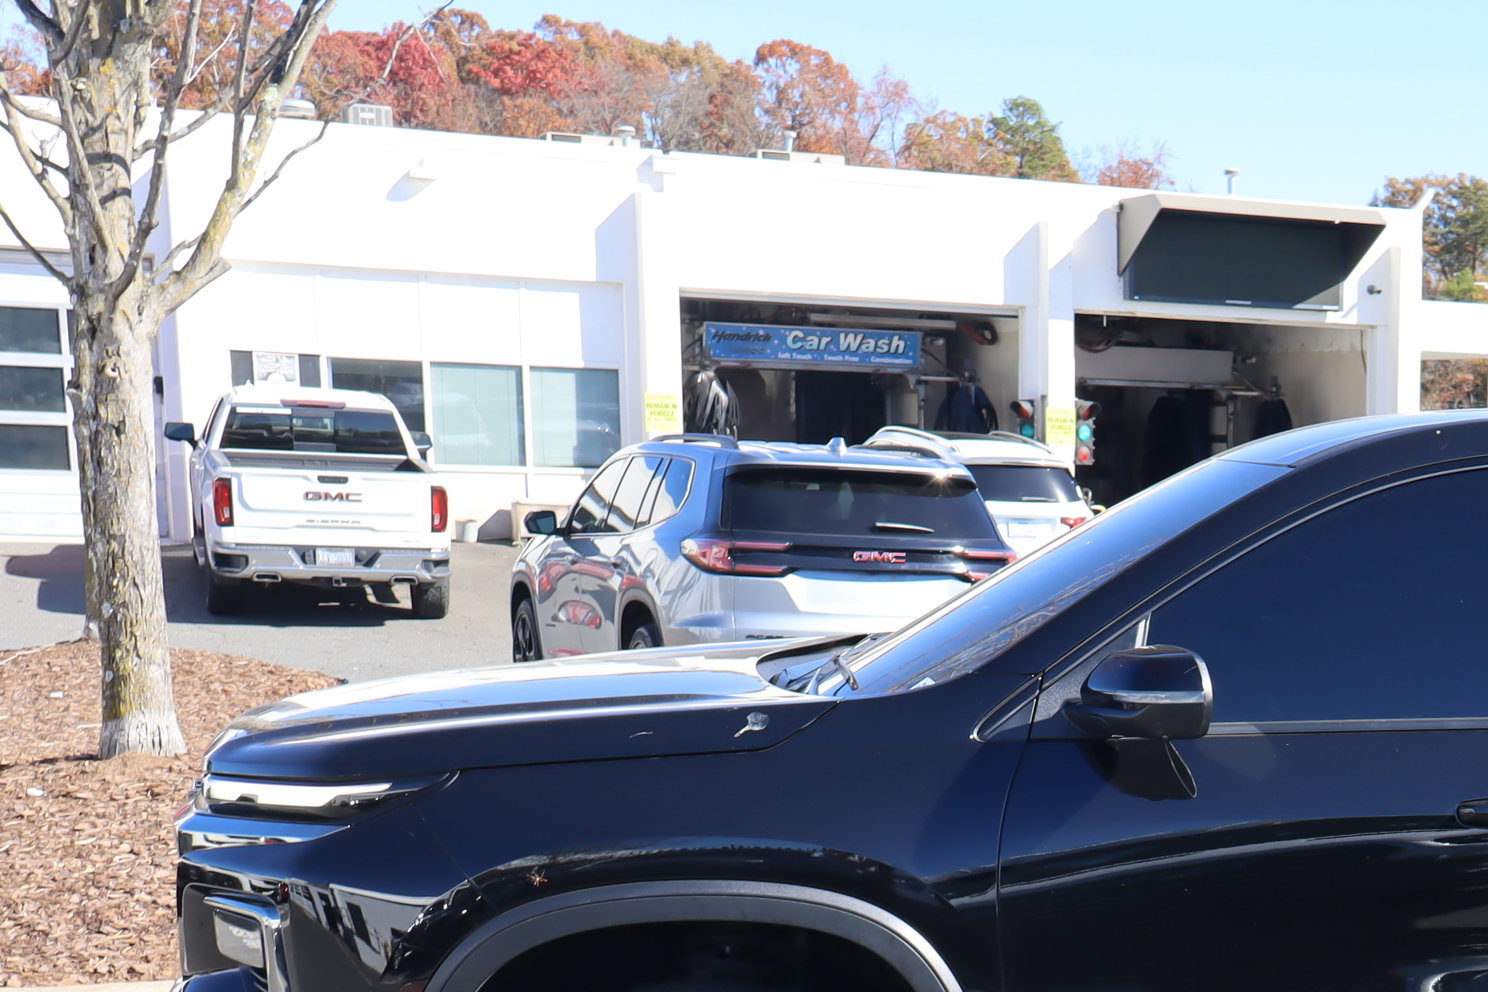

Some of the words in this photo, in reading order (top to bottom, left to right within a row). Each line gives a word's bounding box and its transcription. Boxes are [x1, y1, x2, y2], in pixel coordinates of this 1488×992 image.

[787, 329, 832, 350] Car
[840, 332, 906, 354] Wash
[303, 491, 363, 503] GMC
[853, 550, 907, 564] GMC
